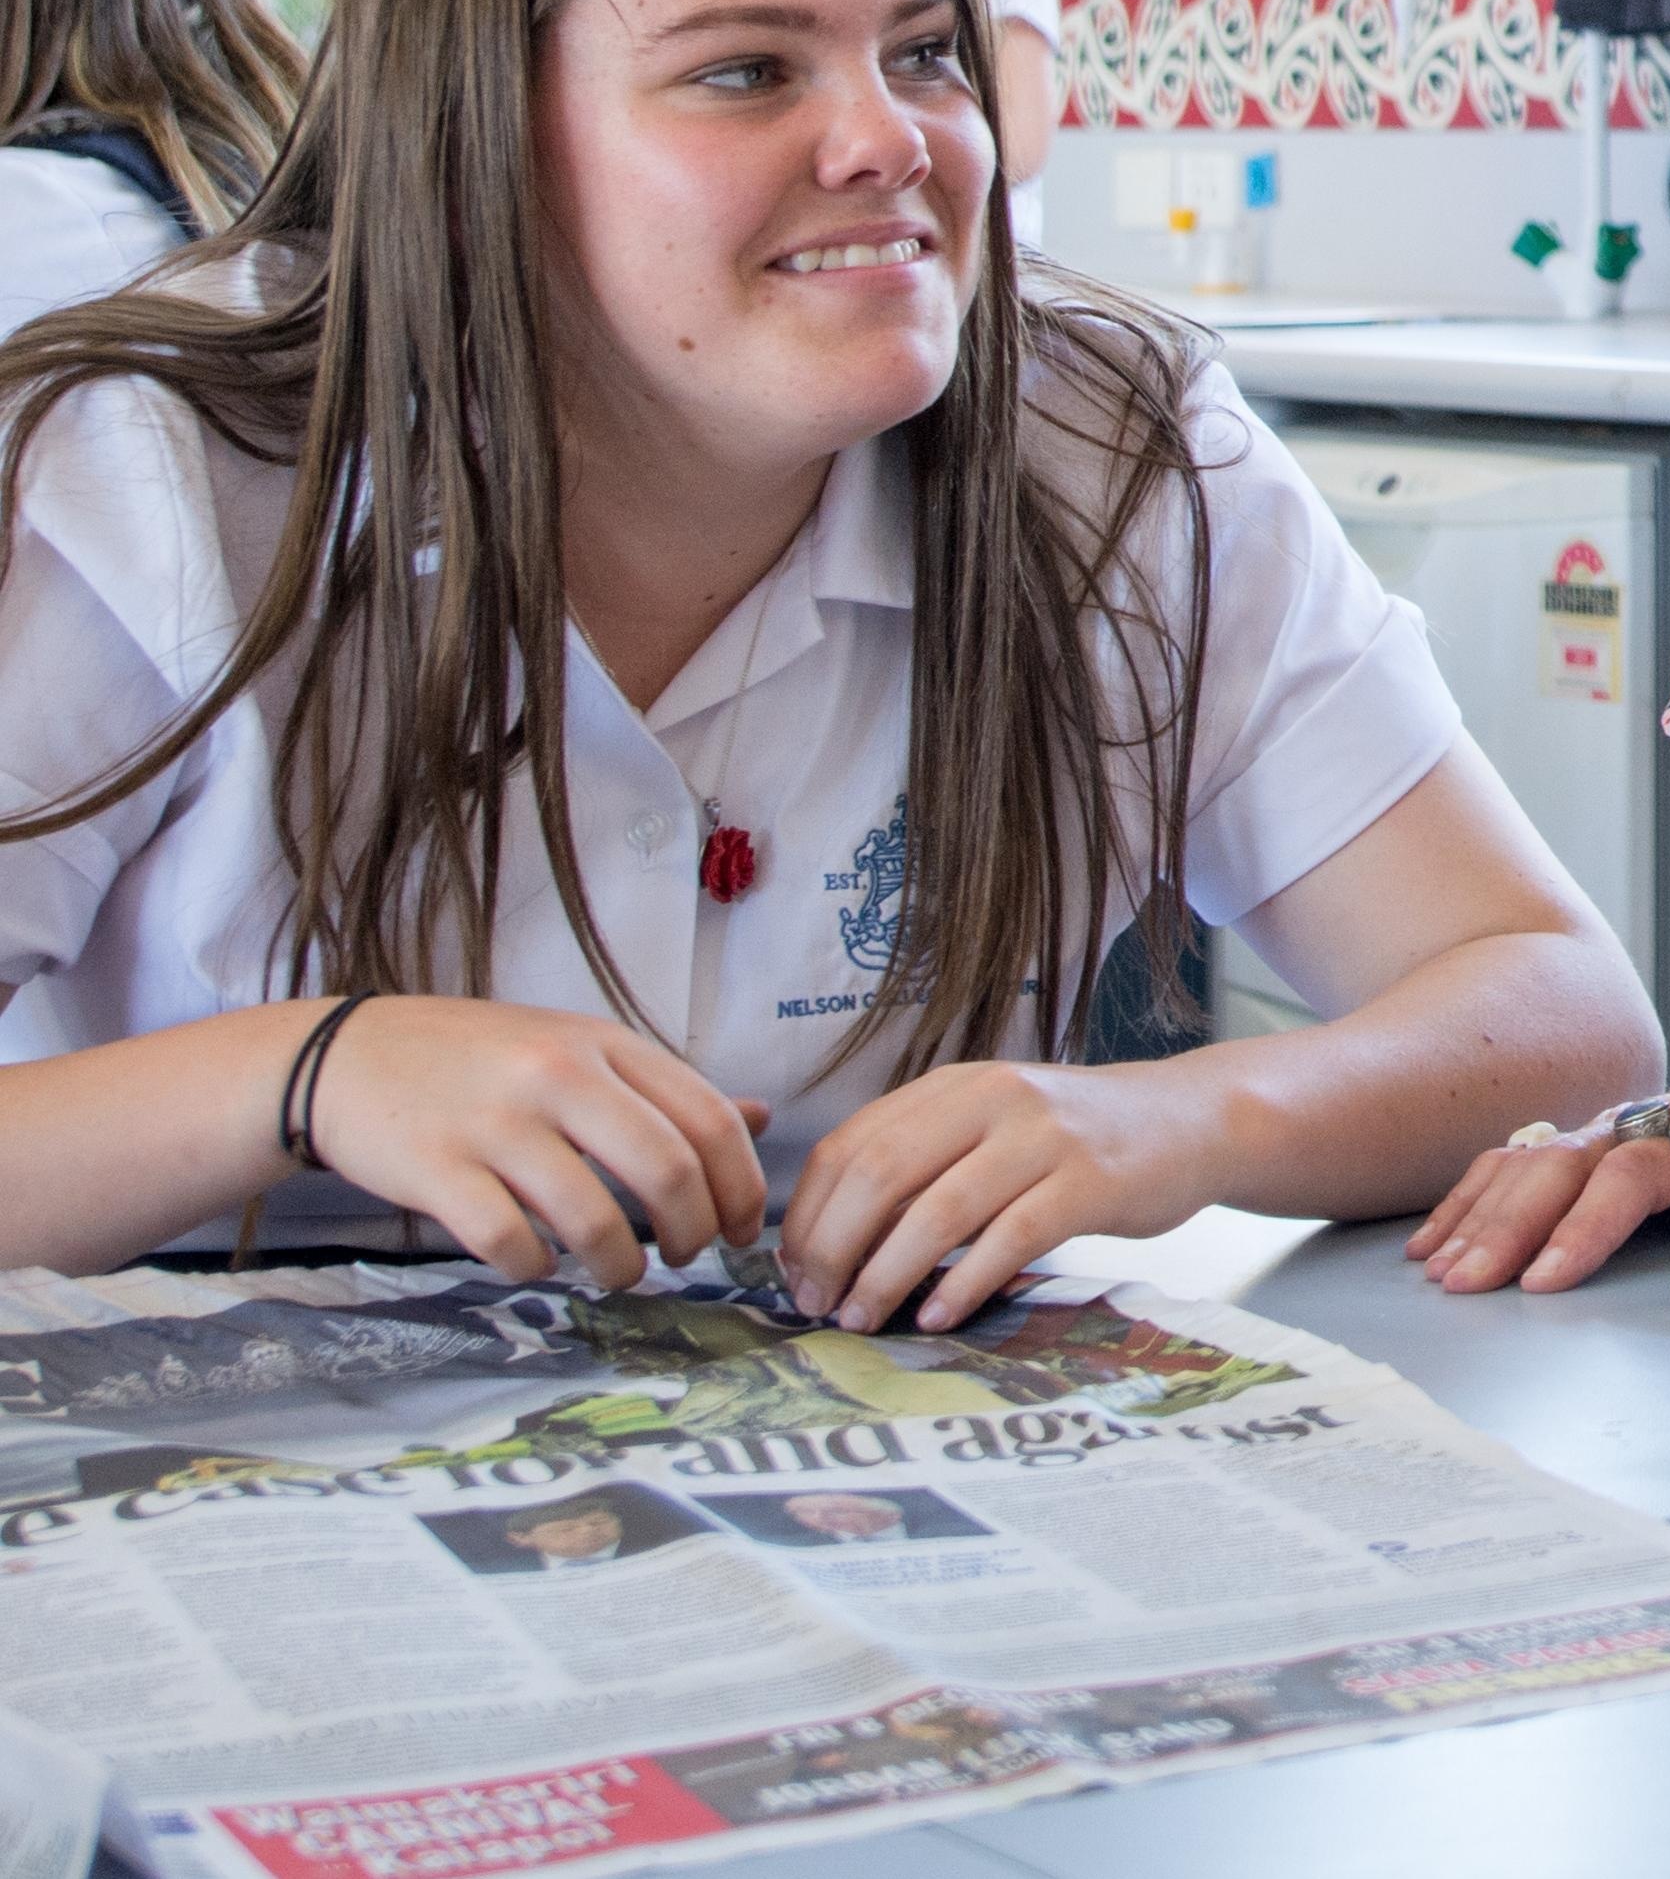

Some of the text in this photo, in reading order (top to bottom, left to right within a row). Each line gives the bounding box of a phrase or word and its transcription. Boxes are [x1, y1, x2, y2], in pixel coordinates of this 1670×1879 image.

[823, 873, 867, 891] EST.
[777, 993, 857, 1019] NELSON
[664, 1419, 920, 1477] and
